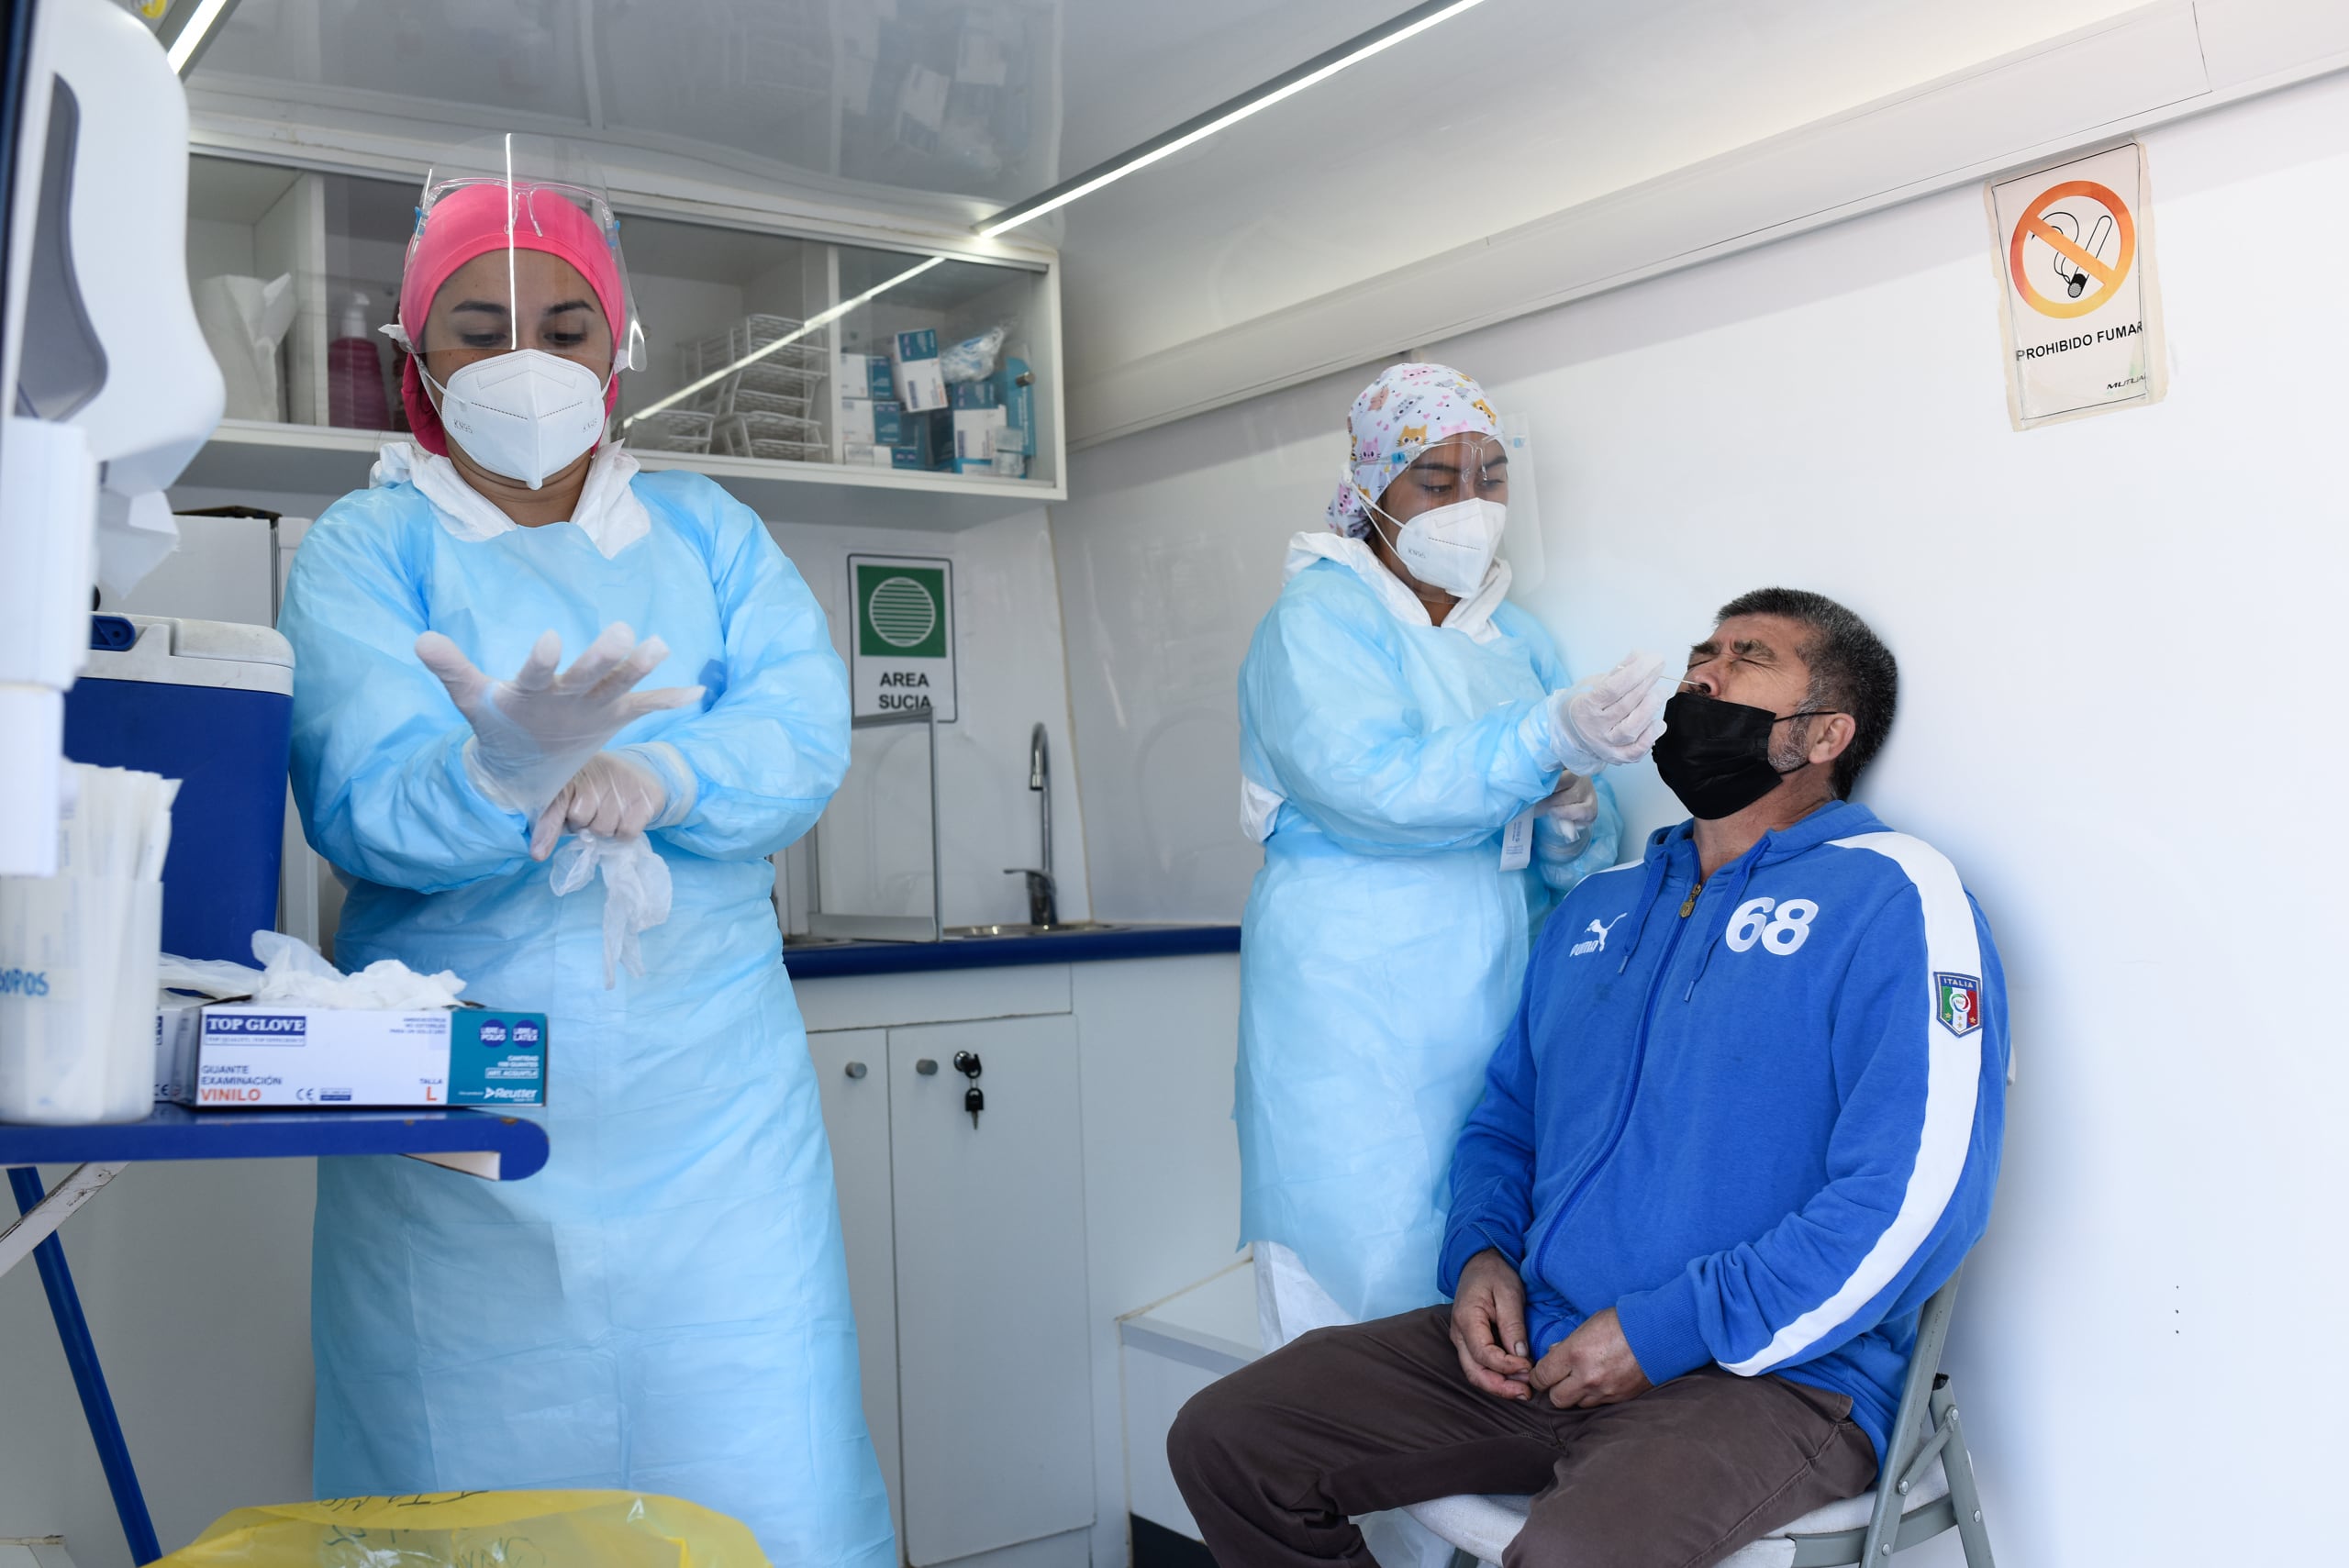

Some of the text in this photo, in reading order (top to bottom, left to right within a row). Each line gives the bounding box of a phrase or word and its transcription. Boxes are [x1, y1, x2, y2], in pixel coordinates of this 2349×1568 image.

[2015, 334, 2093, 361] PROHIBIDO
[879, 672, 930, 687] AREA
[878, 694, 931, 710] SUCIA
[1725, 896, 1819, 956] 68
[1943, 978, 1974, 988] ITALIA
[207, 1018, 306, 1032] TOP GLOVE
[201, 1065, 250, 1074] GUANTE
[201, 1074, 283, 1085] EXAMINACIÓN
[200, 1088, 262, 1101] VINILO
[295, 1088, 315, 1101] CE
[426, 1086, 438, 1101] L
